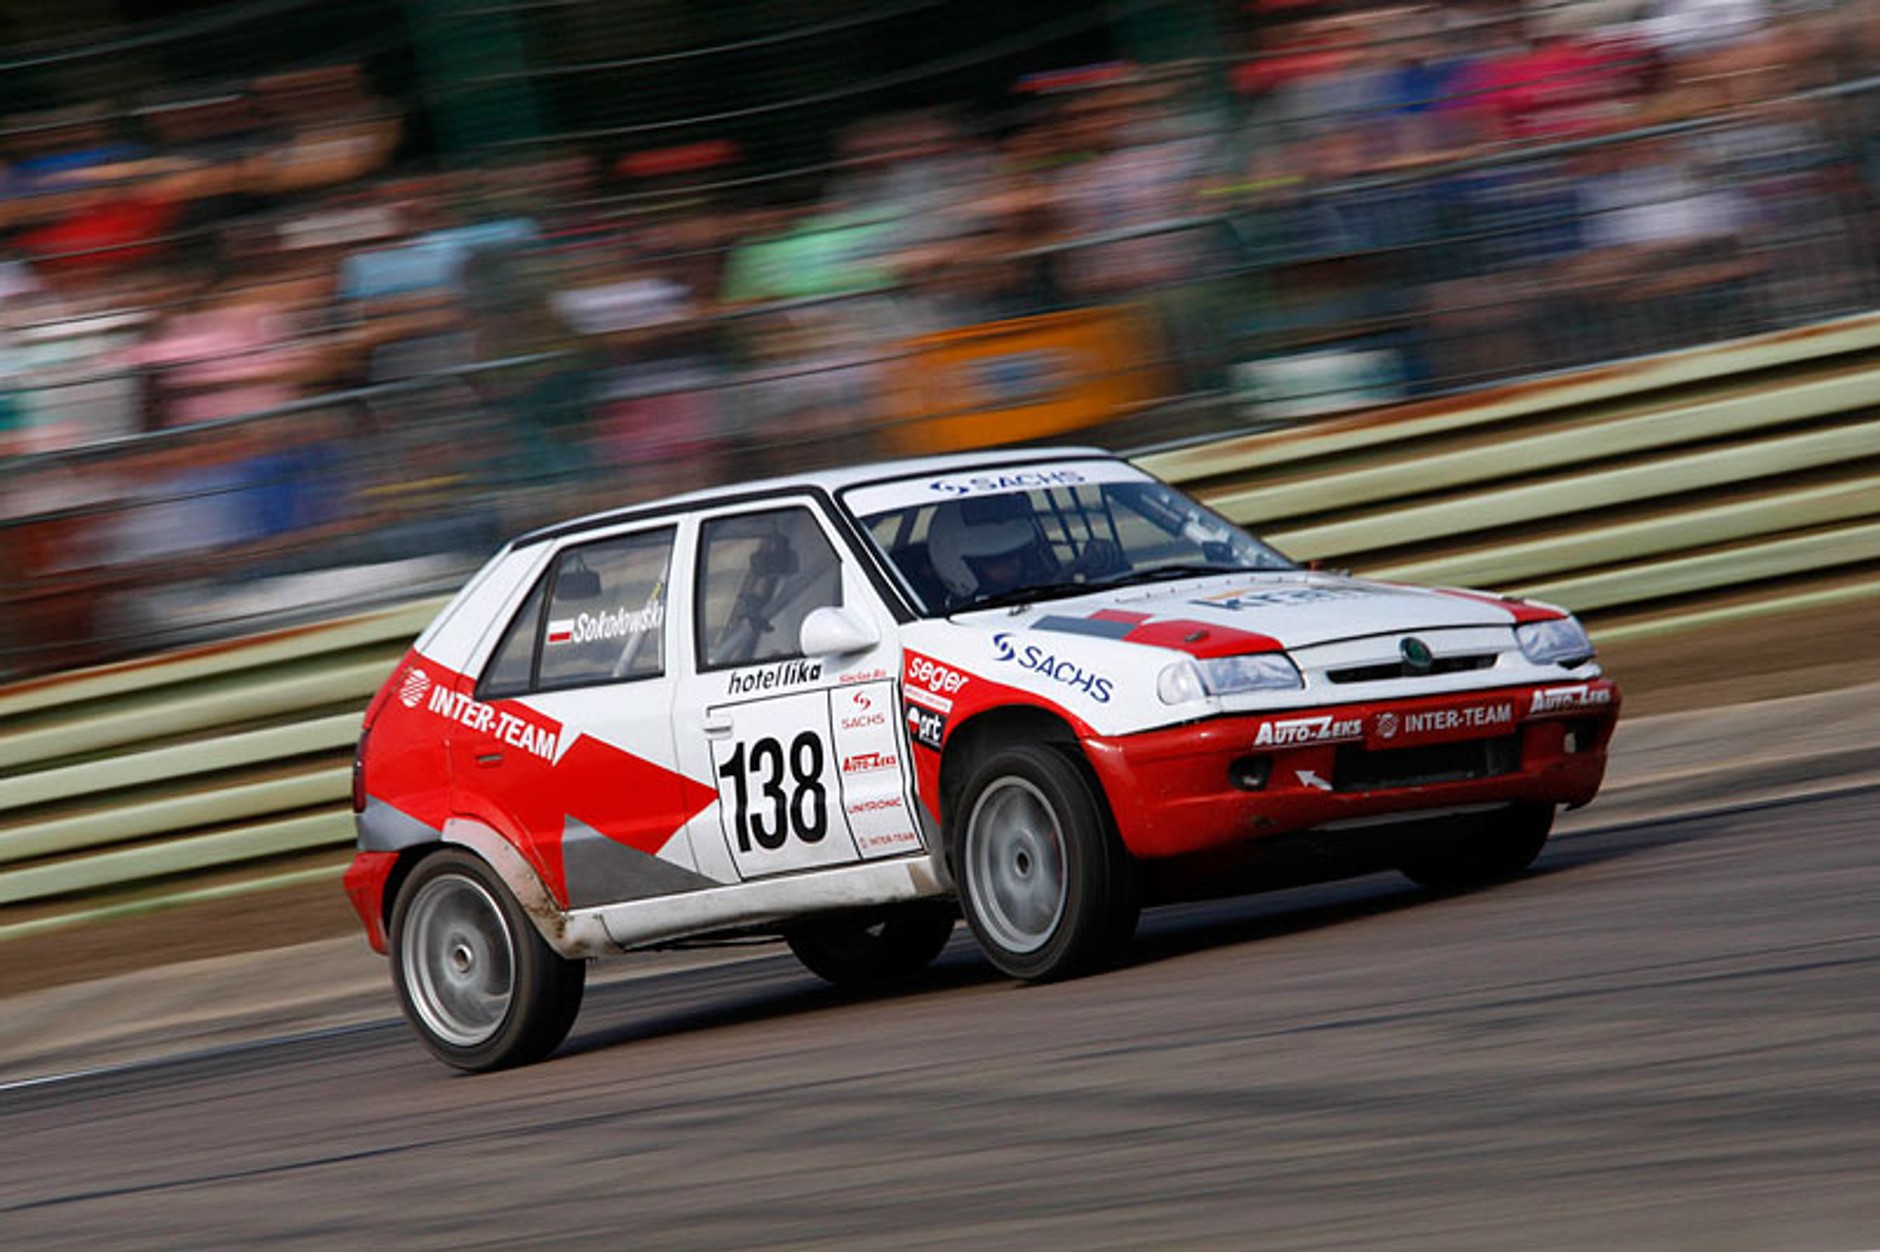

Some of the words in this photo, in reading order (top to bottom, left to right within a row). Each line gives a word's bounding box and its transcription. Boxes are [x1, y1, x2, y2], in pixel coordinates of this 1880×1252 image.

[970, 471, 1086, 490] SACHS
[909, 657, 970, 693] seger
[1017, 645, 1114, 704] SACHS
[428, 684, 557, 762] INTER-TEAM
[841, 714, 886, 730] SACHS
[1404, 703, 1512, 733] INTER-TEAM
[719, 730, 827, 852] 138
